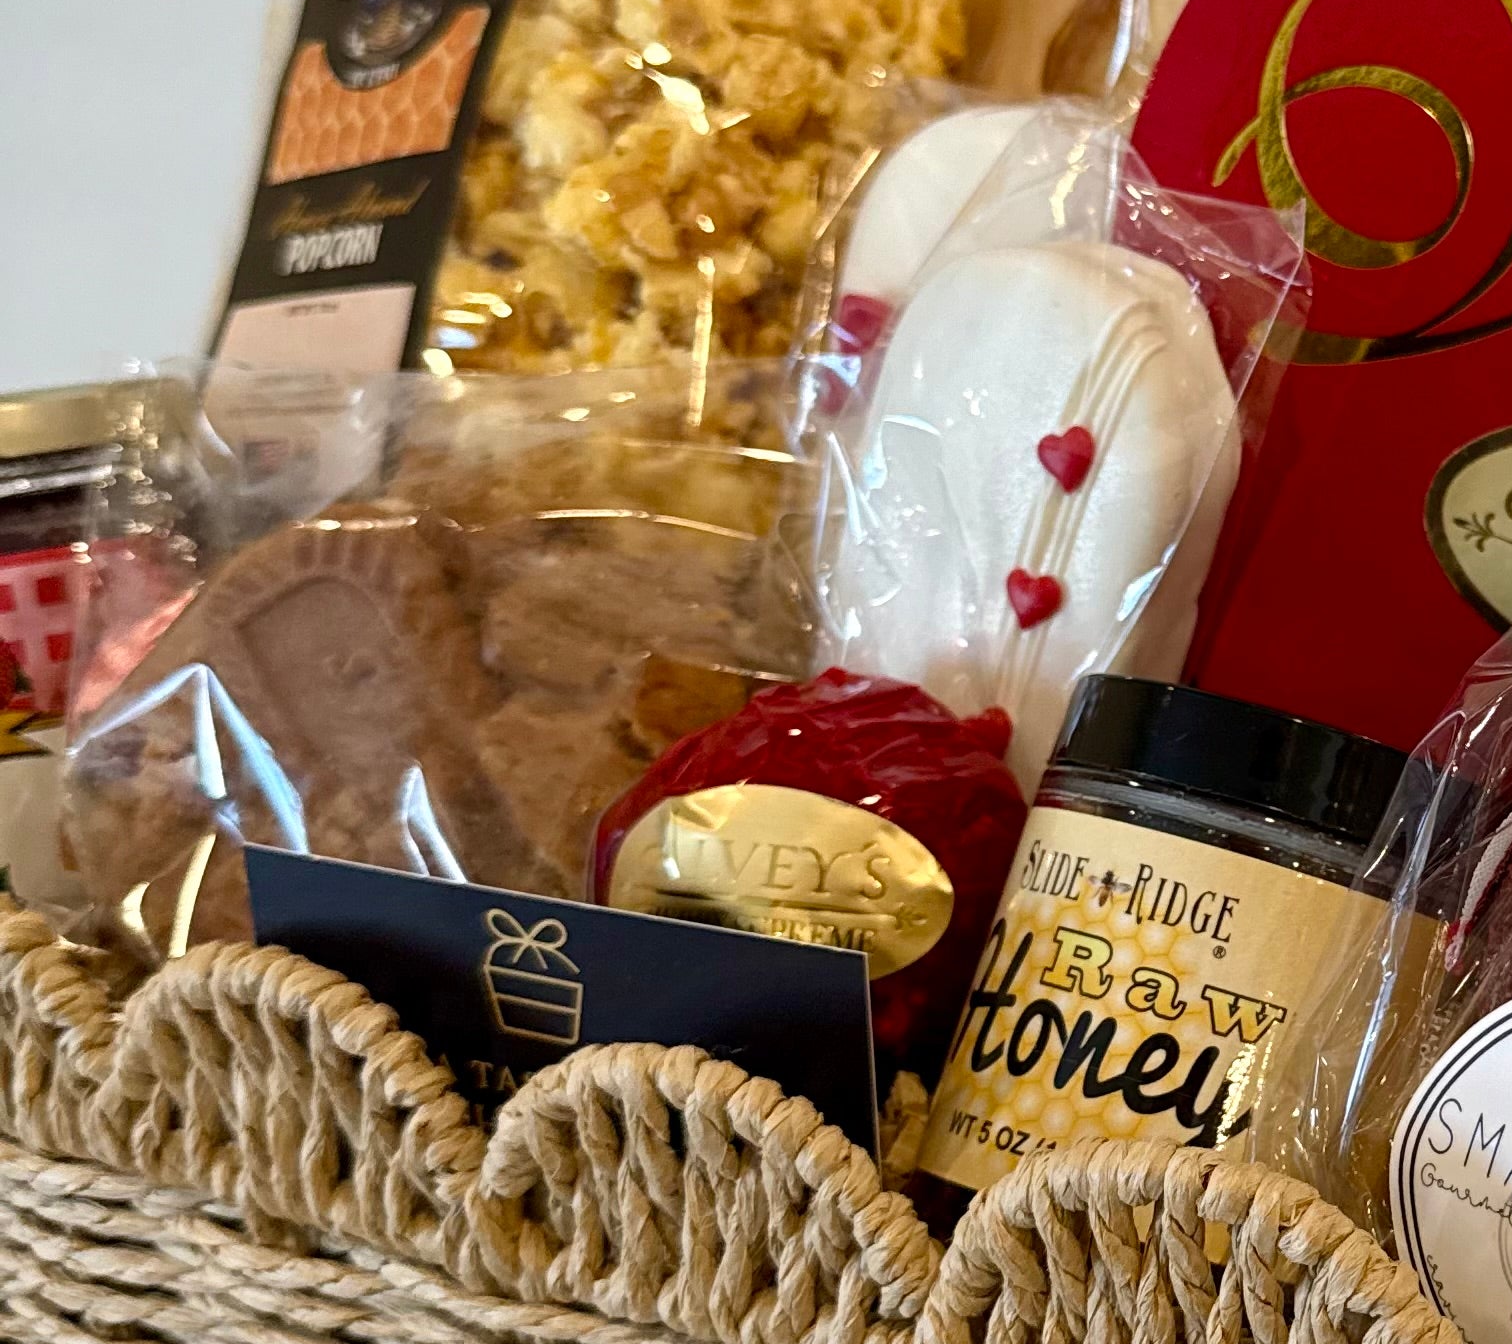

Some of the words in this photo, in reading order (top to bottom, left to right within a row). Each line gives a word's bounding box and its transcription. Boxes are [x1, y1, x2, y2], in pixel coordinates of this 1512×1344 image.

[276, 222, 384, 276] POPCORN
[1021, 839, 1090, 901] SLIDE
[1125, 863, 1240, 943] RIDGE
[951, 918, 1253, 1149] Honey
[1040, 926, 1287, 1044] Raw
[949, 1109, 978, 1138] WT
[978, 1120, 992, 1144] 5
[995, 1125, 1030, 1156] OZ
